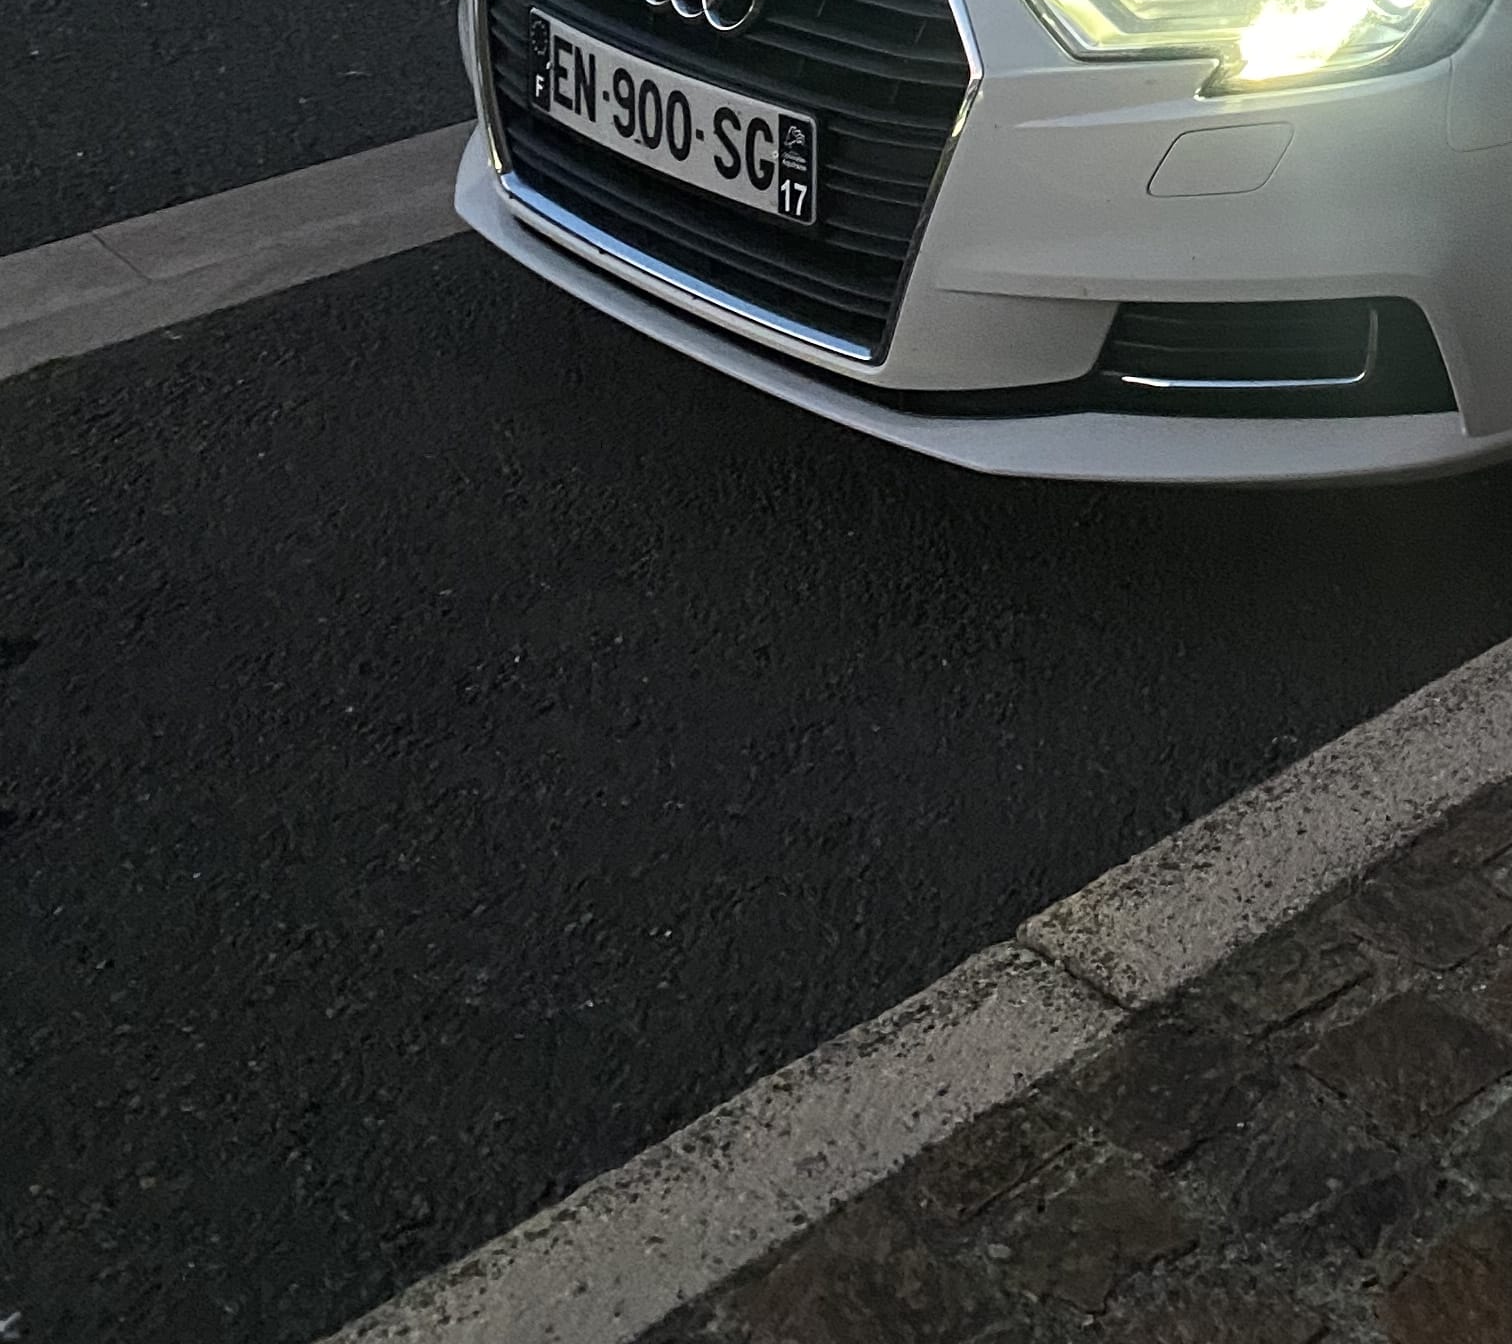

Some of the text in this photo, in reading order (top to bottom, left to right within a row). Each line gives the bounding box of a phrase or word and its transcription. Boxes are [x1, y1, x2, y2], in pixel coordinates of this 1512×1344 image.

[535, 74, 545, 97] F
[553, 34, 775, 192] EN-900-SG
[780, 178, 808, 216] 17
